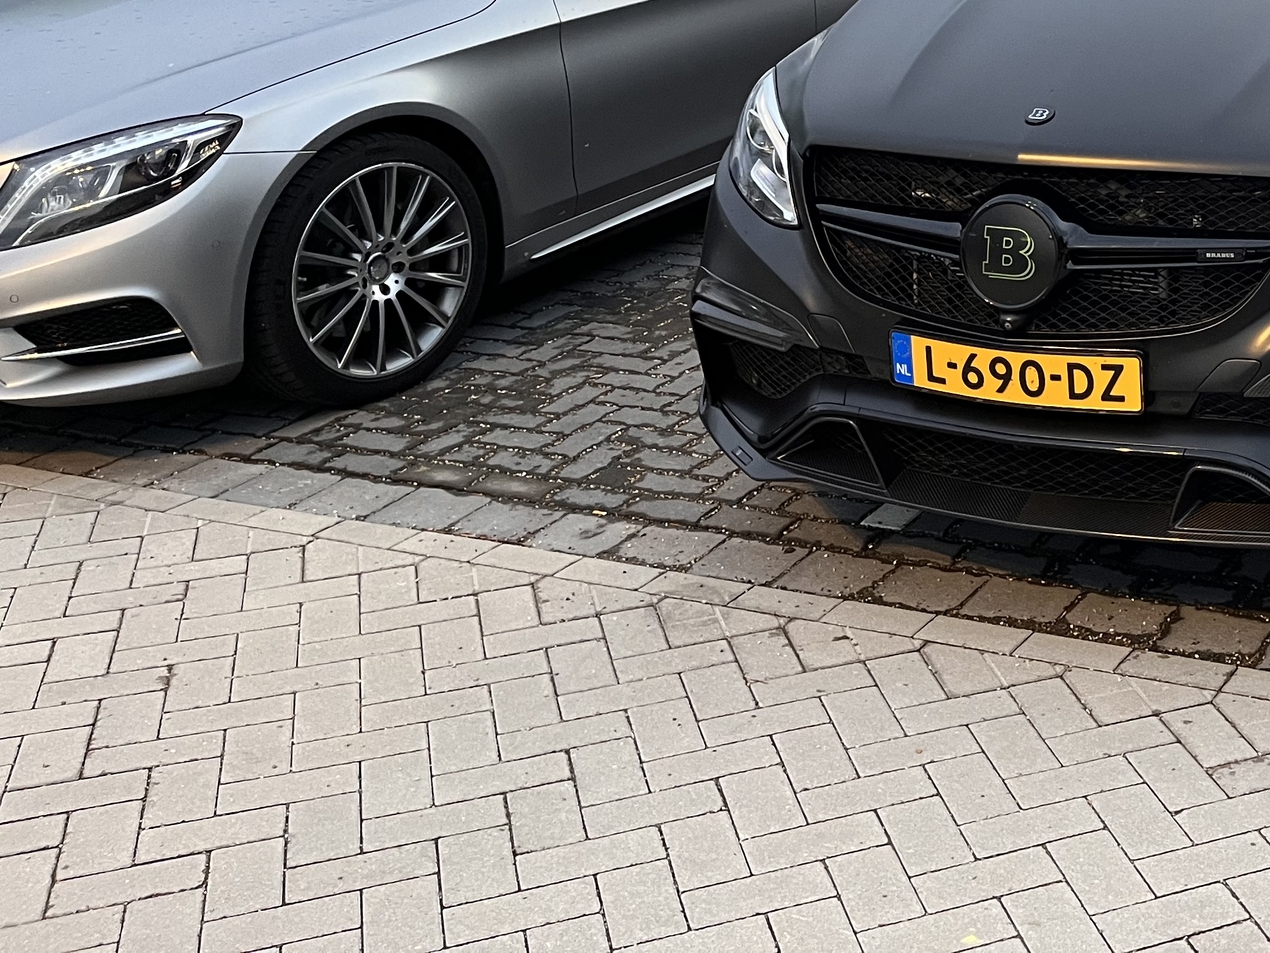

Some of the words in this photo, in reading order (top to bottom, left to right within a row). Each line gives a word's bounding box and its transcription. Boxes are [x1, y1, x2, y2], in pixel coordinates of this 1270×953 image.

[982, 225, 1036, 281] B
[896, 362, 911, 377] NL
[925, 345, 1126, 403] L-690-DZ
